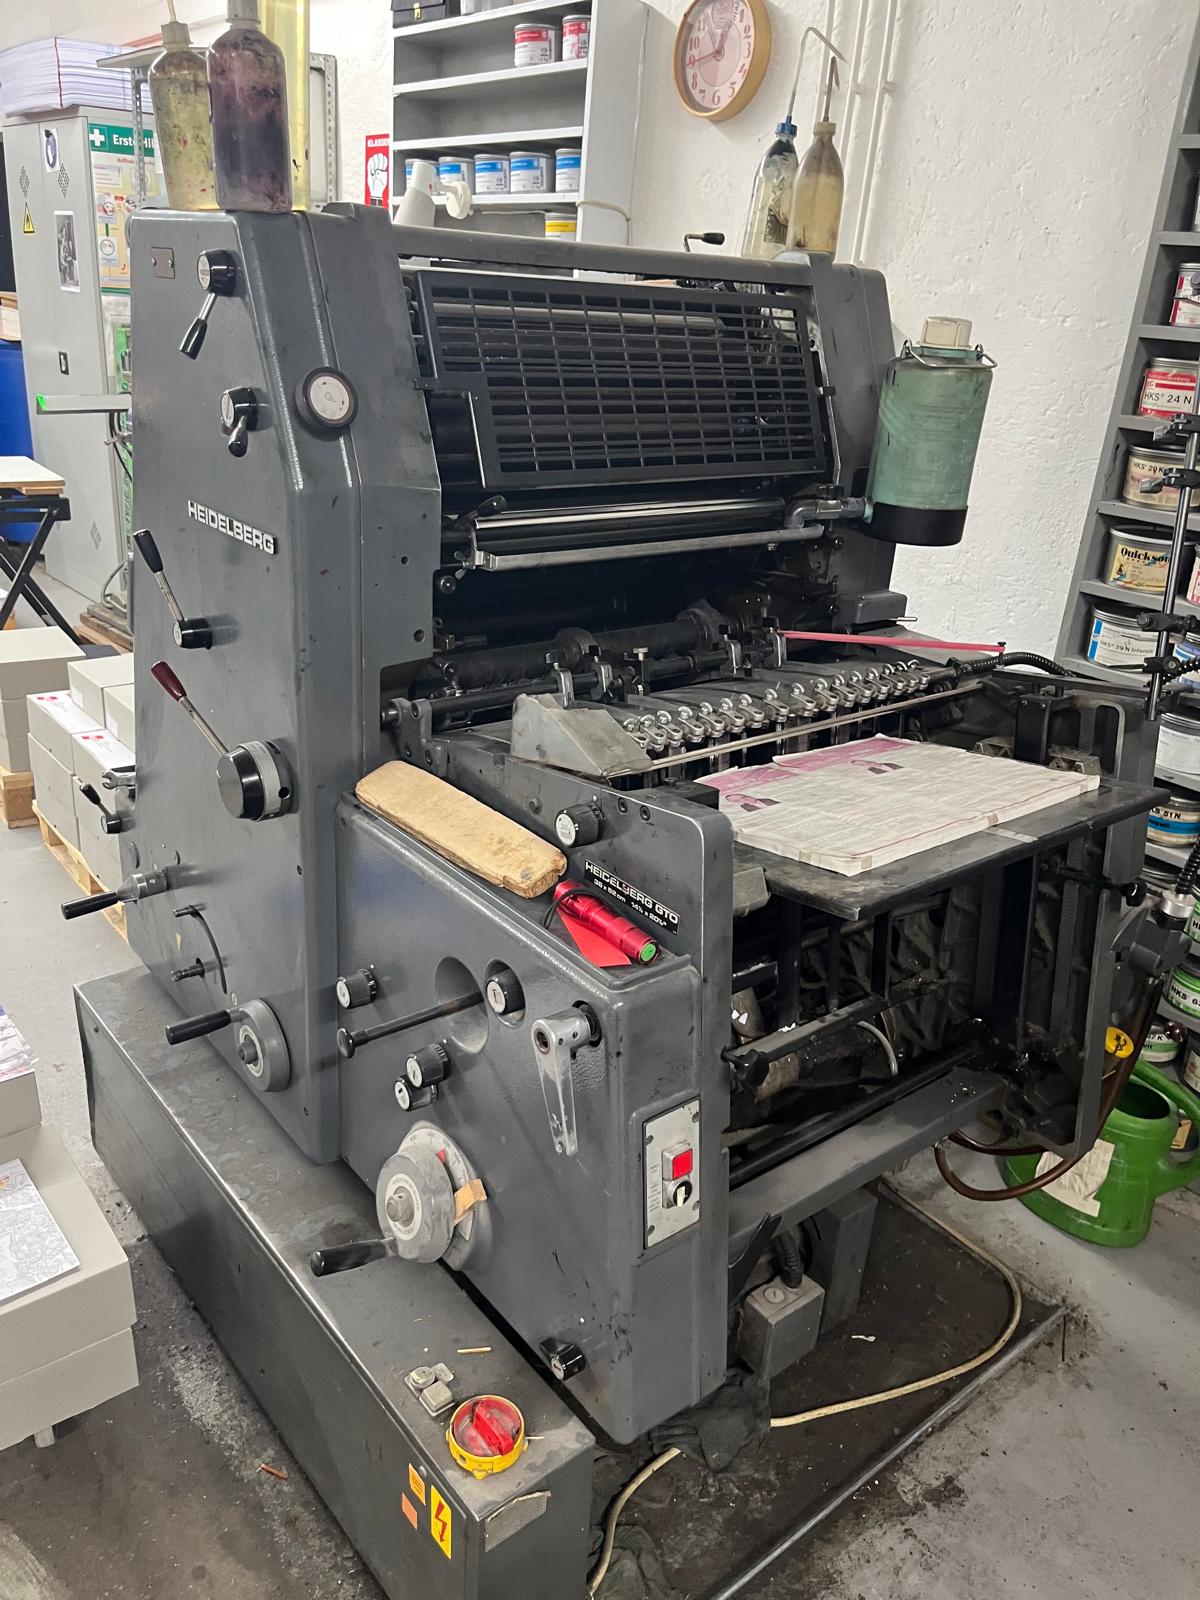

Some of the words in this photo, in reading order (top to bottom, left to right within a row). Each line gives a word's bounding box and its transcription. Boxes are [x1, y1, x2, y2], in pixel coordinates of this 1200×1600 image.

[712, 89, 721, 106] 6
[1167, 395, 1180, 404] 24
[1183, 396, 1192, 405] N
[188, 500, 275, 555] HEIDELBERG
[655, 903, 679, 925] GTO
